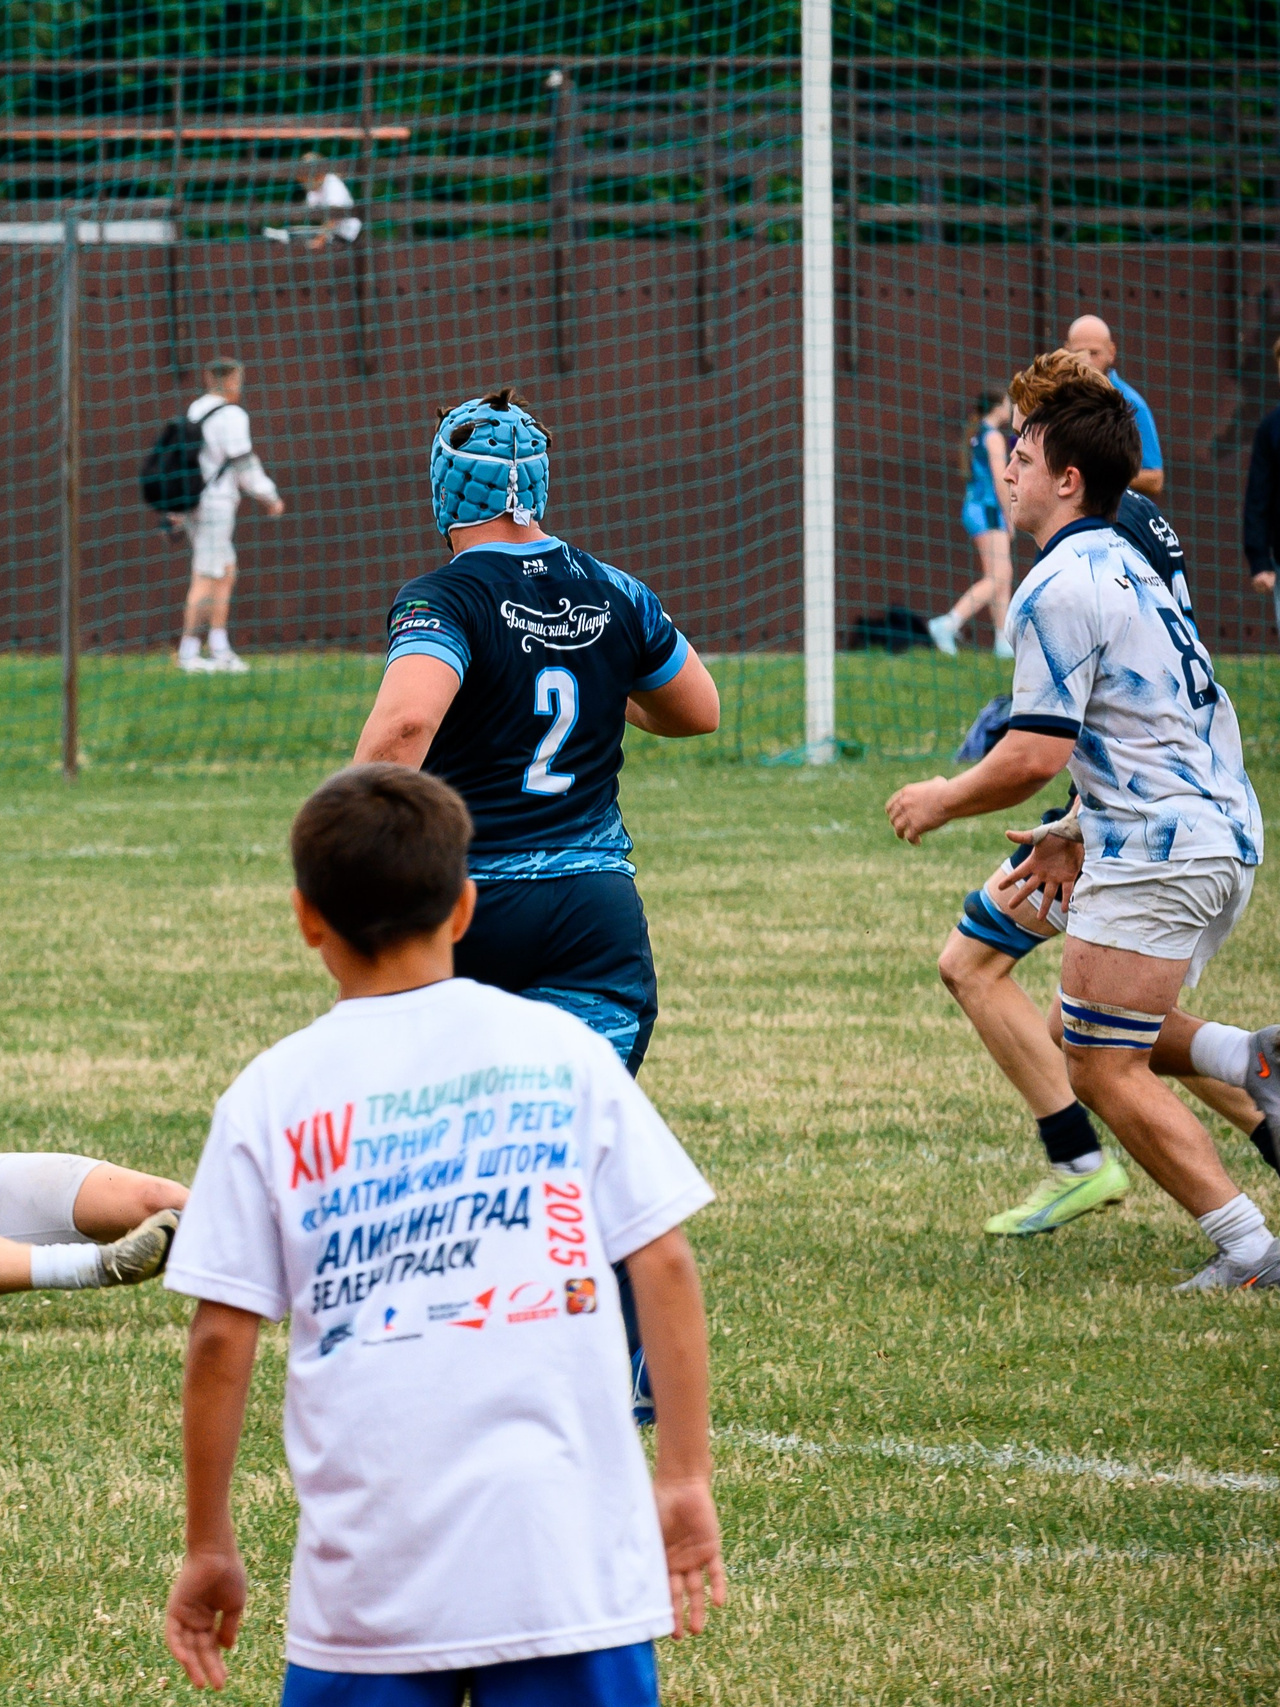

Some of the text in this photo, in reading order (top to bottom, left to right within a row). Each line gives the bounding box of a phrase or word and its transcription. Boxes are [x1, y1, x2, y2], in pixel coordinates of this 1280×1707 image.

[500, 599, 570, 638] Балтиский
[1156, 607, 1219, 709] 8
[521, 666, 580, 796] 2
[285, 1102, 354, 1190] XIV
[353, 1117, 450, 1171] ТУРНИР
[462, 1107, 496, 1145] ПО
[477, 1142, 580, 1178] ШТОРМ
[316, 1185, 531, 1276] АЛИНИНГРАД
[543, 1181, 587, 1267] 2025
